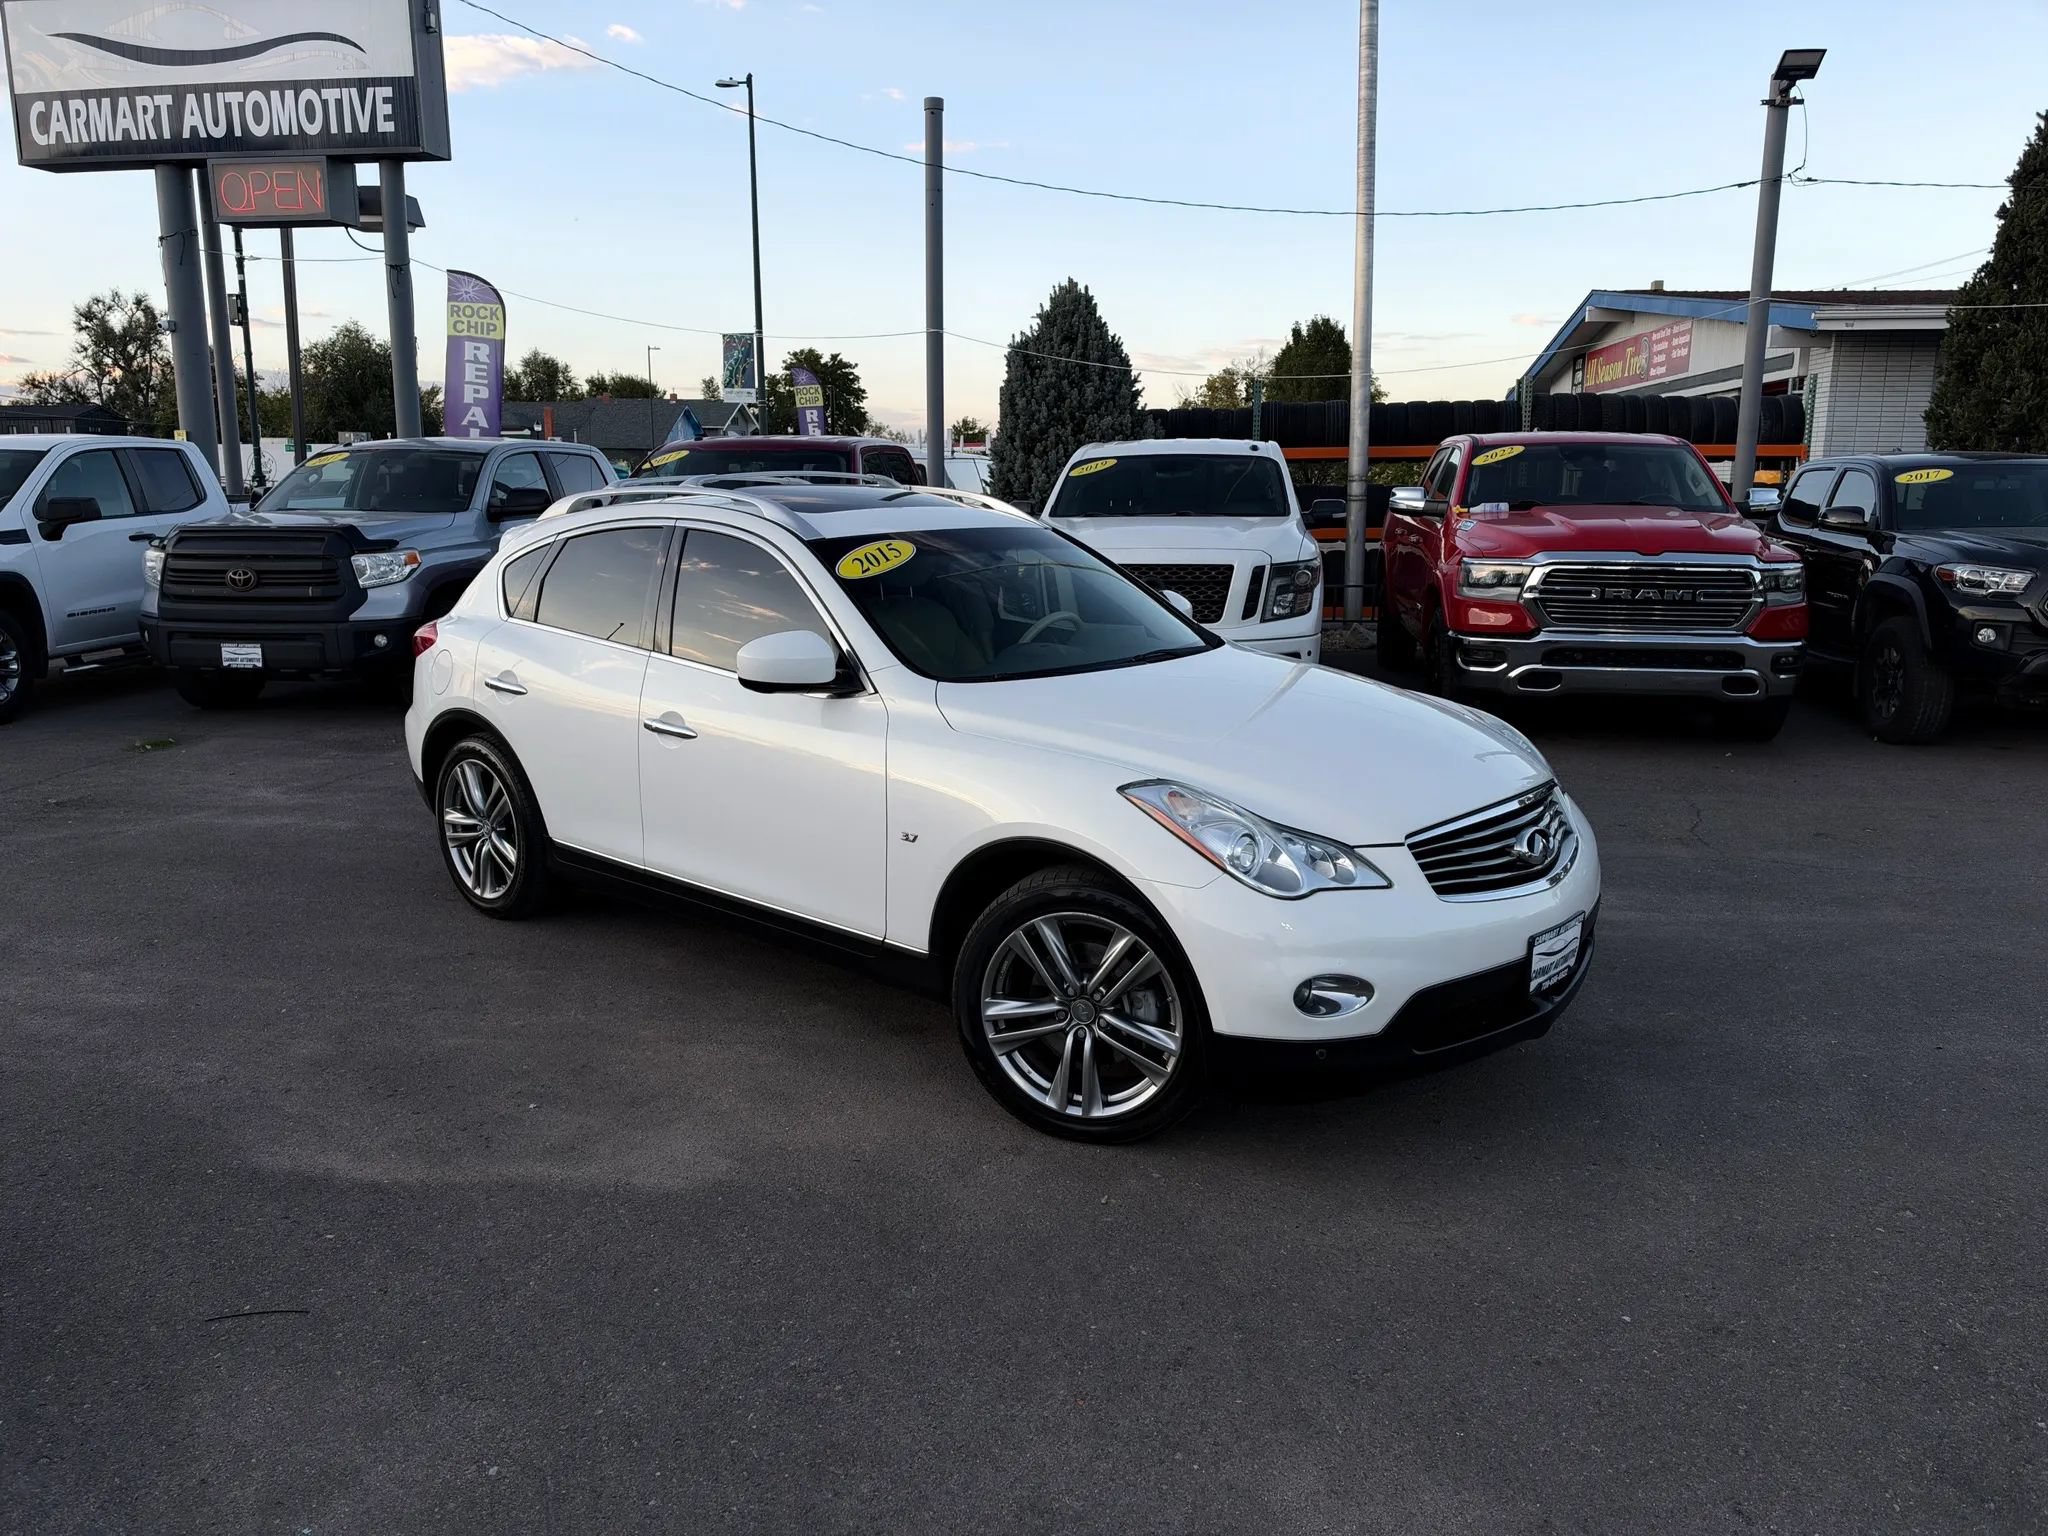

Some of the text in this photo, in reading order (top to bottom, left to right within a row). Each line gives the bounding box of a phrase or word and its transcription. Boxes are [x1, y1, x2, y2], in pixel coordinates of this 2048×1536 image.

[29, 86, 395, 146] CARMART AUTOMOTIVE
[219, 169, 323, 212] OPEN
[450, 304, 500, 321] ROCK
[452, 319, 498, 336] CHIP
[1596, 356, 1623, 384] Season
[795, 386, 821, 396] ROCK
[799, 396, 820, 406] CHIP
[1482, 447, 1514, 462] 2022
[1906, 470, 1941, 482] 2017
[851, 542, 902, 575] 2015
[1604, 587, 1693, 600] RAM
[66, 606, 116, 618] SIERRA
